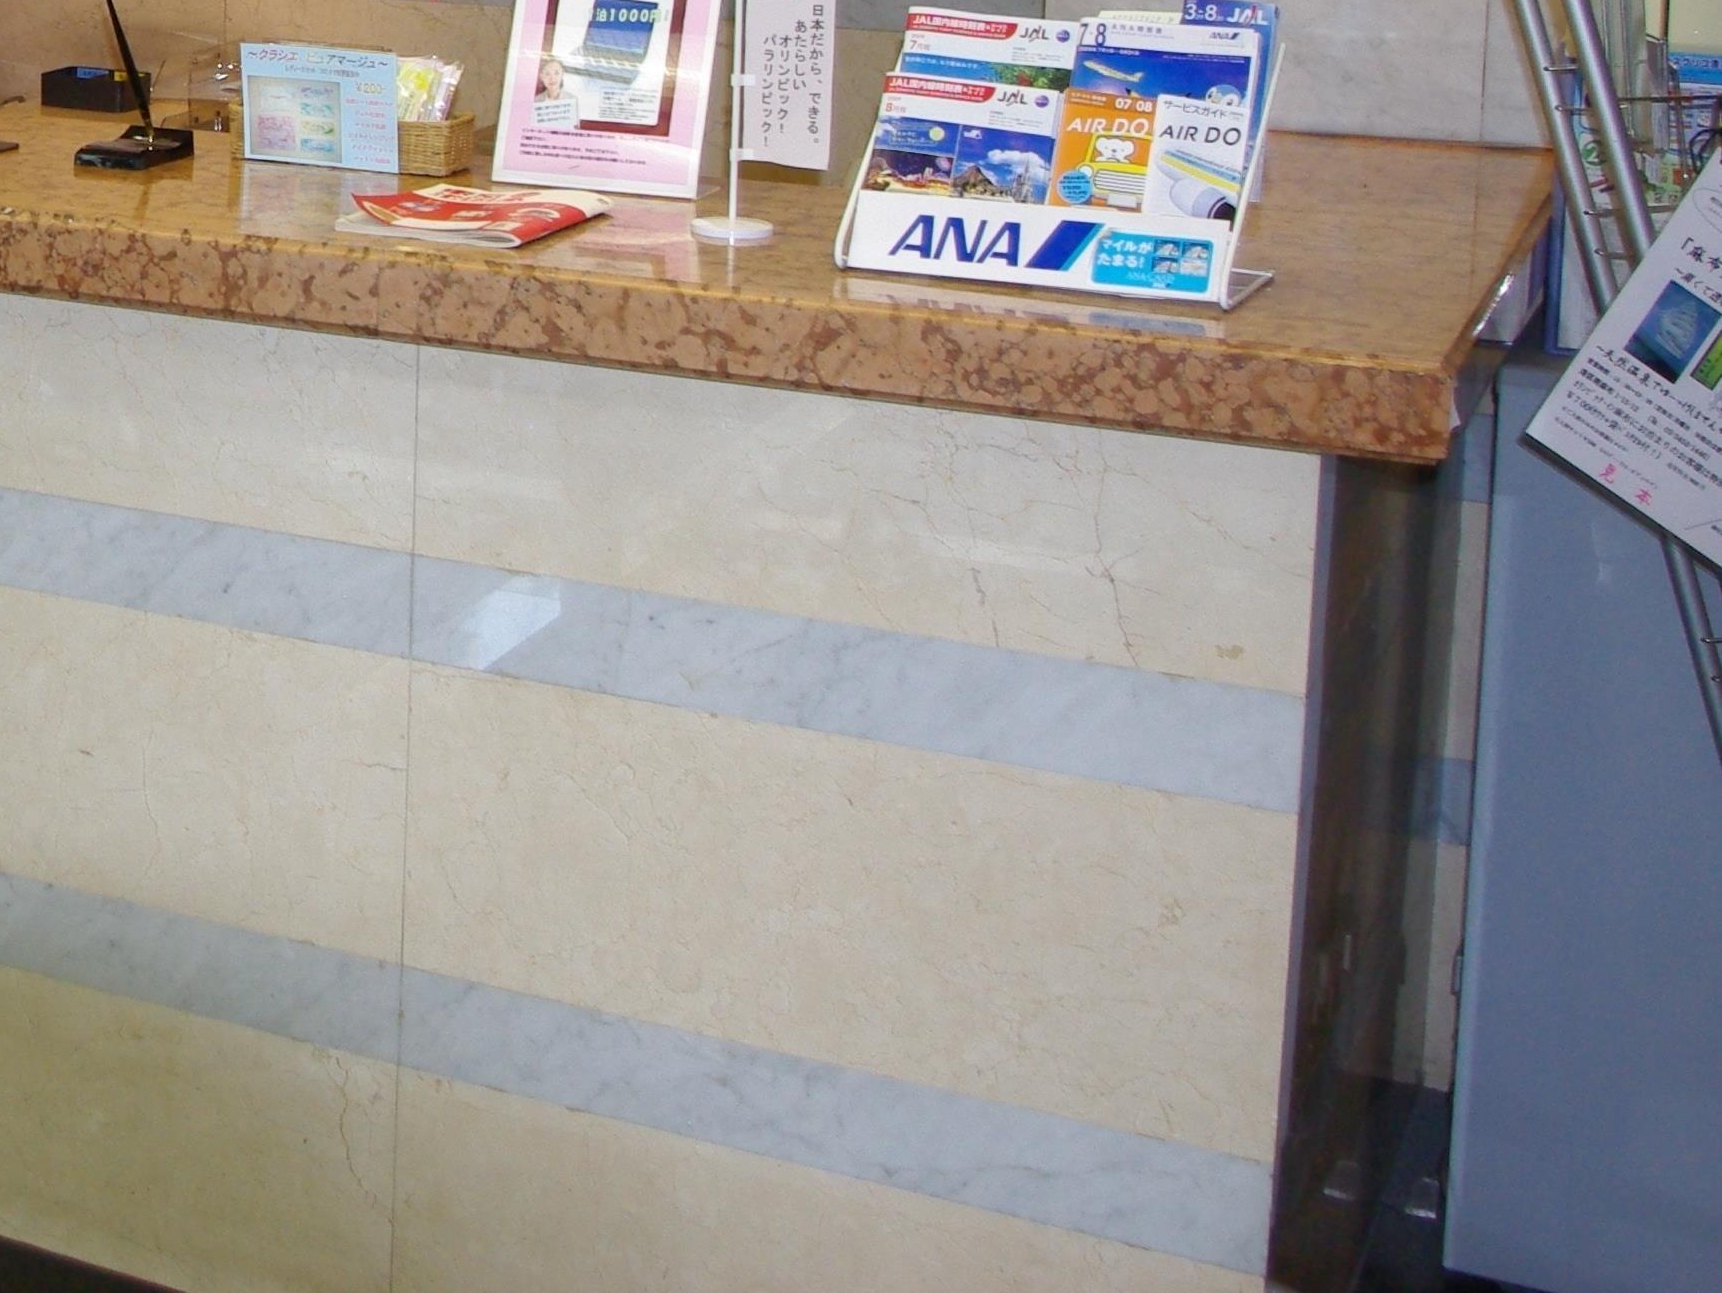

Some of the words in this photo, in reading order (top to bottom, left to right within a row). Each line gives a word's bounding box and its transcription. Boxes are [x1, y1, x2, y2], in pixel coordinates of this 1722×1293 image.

[1226, 5, 1270, 26] JAL
[1019, 25, 1050, 42] JAL
[793, 19, 807, 91] あたらしい
[997, 89, 1028, 106] JAL
[1115, 97, 1130, 110] 07
[1136, 100, 1153, 113] 08
[1163, 99, 1228, 118] サービスガイド
[1067, 117, 1107, 134] AIR
[1112, 118, 1149, 138] DO
[1159, 125, 1197, 143] AIR
[1204, 126, 1241, 146] DO
[889, 214, 1022, 268] ANA
[1100, 238, 1153, 254] マイルが
